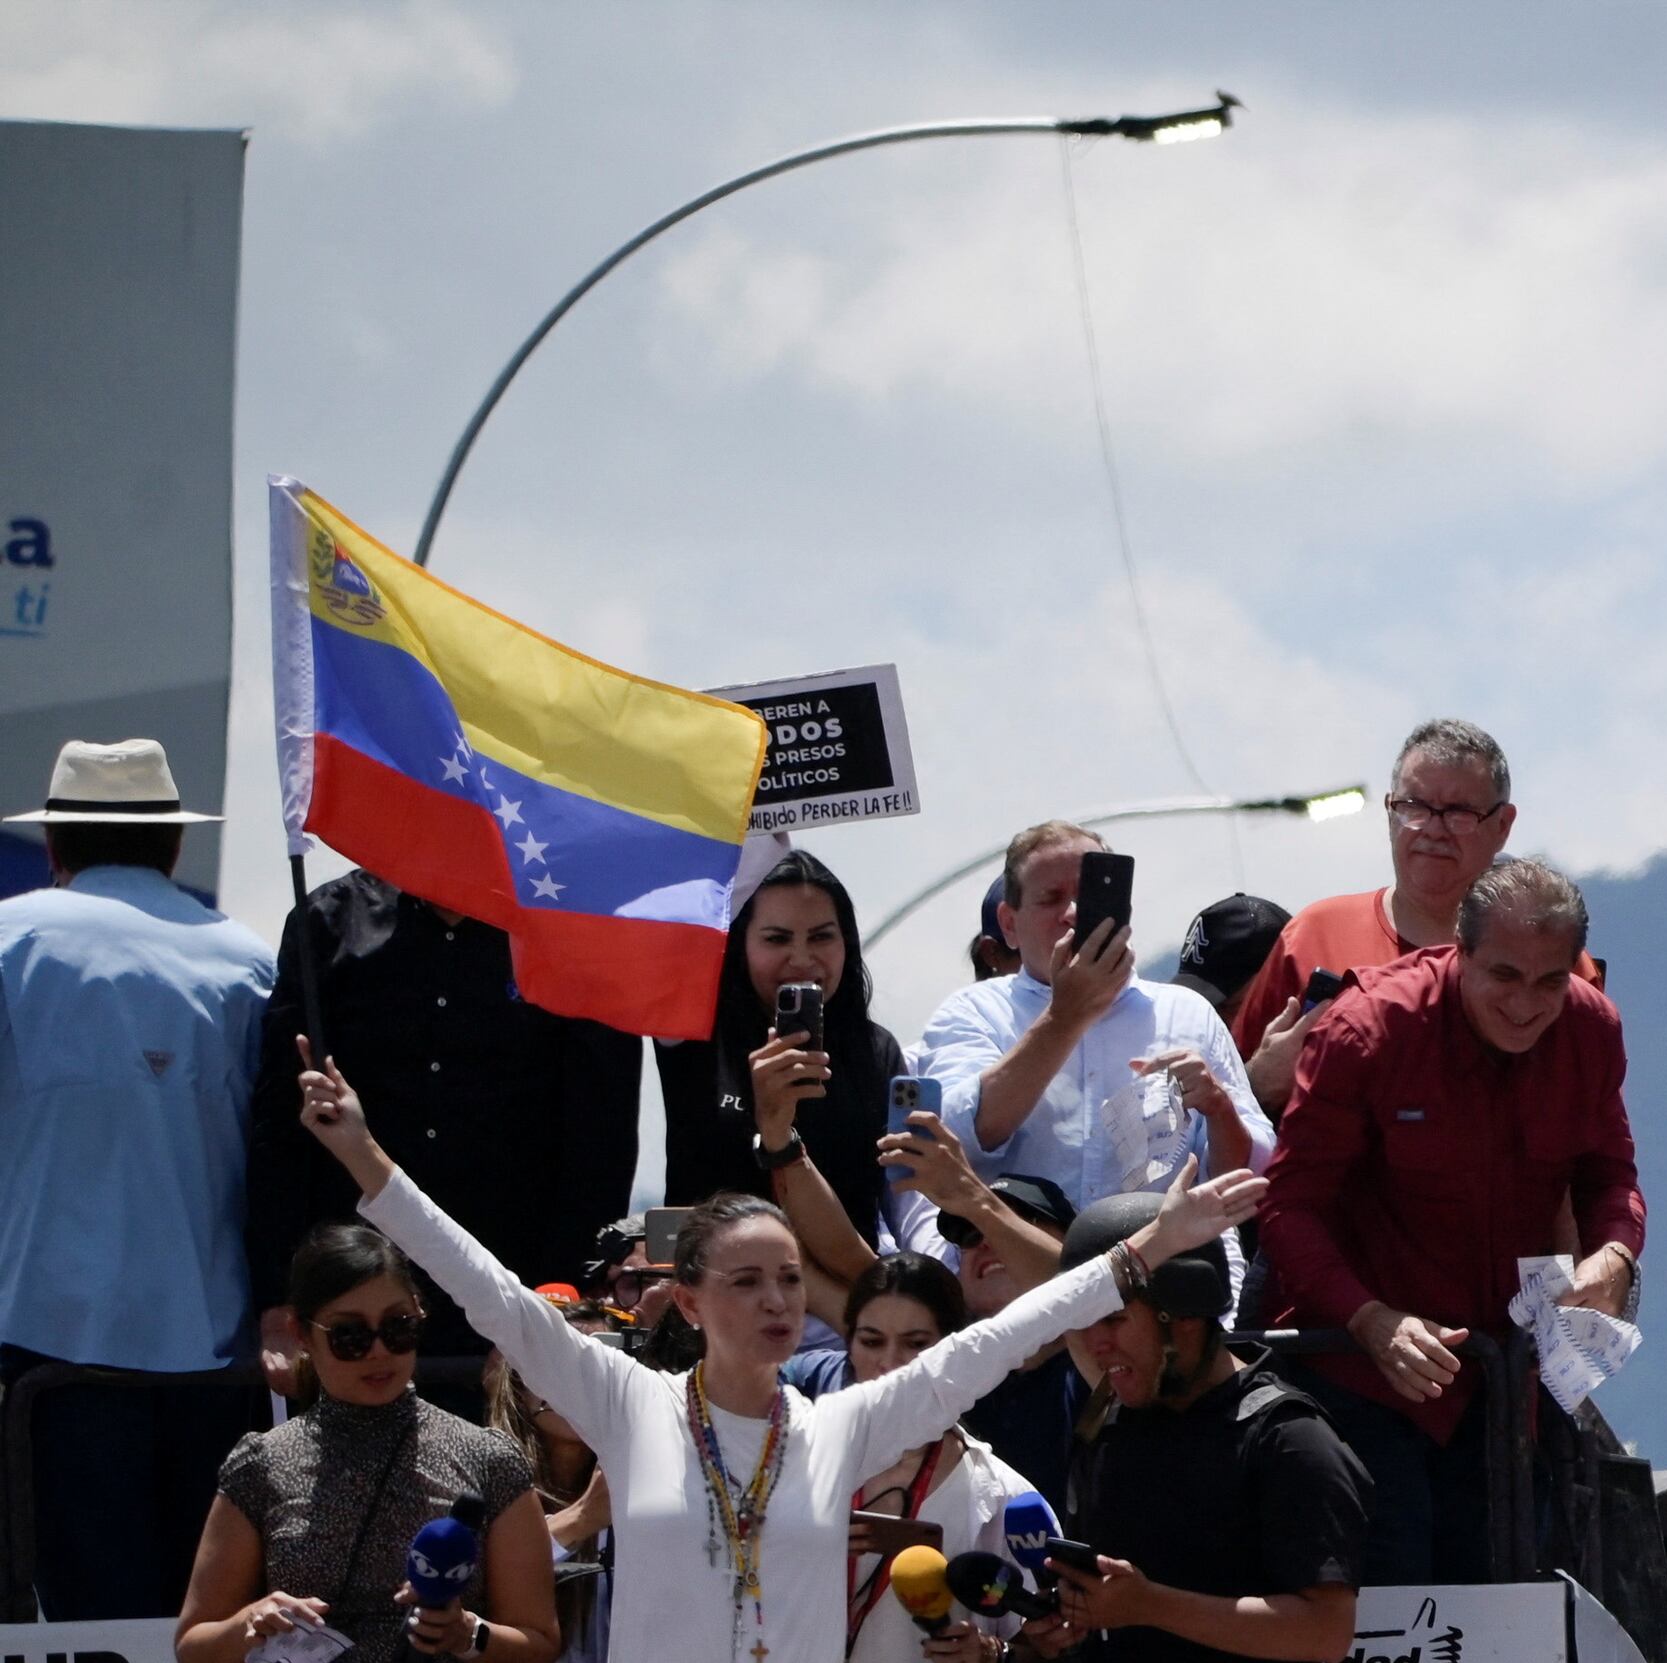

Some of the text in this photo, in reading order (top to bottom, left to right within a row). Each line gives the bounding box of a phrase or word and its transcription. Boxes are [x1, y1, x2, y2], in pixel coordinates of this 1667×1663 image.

[15, 584, 49, 625] ti
[817, 700, 830, 714] A
[767, 718, 843, 747] DOS
[776, 743, 846, 766] PRESOS
[802, 800, 860, 822] PERDER
[864, 796, 880, 815] LA
